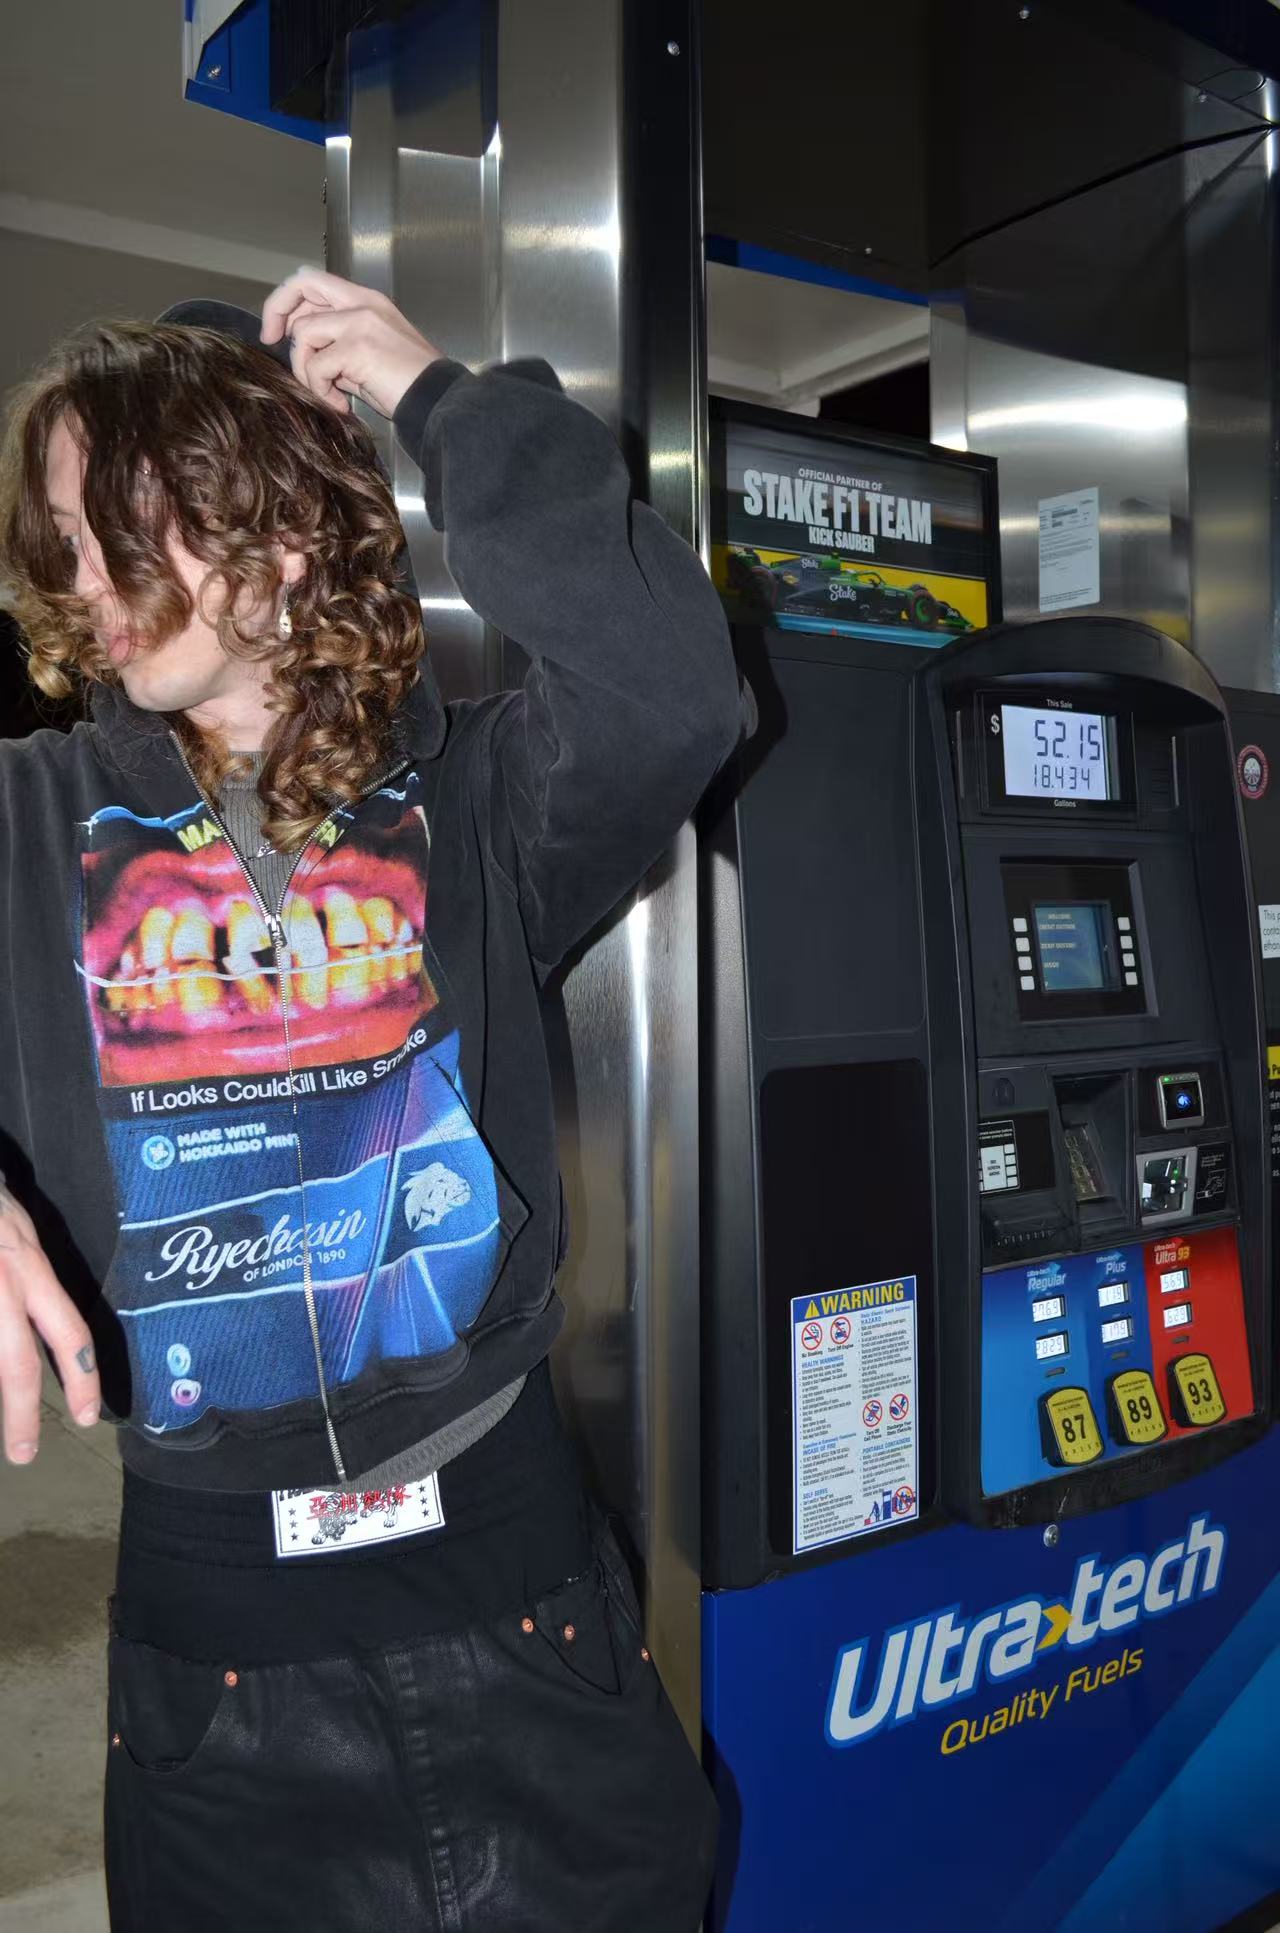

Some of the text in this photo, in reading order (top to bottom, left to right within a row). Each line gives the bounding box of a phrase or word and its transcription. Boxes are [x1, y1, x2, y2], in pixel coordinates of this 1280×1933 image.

[798, 467, 883, 492] OFFICIAL PARTNER OF
[743, 469, 932, 545] STAKE F1 TEAM
[808, 525, 875, 554] KICK SAUBER
[829, 583, 857, 601] Stake
[1046, 699, 1073, 709] This Sale
[990, 714, 1000, 735] $
[1034, 764, 1091, 790] 18.434
[1054, 799, 1077, 808] Gallons
[130, 1091, 145, 1113] If
[149, 1084, 218, 1111] Looks
[223, 1077, 291, 1102] Could
[321, 1069, 368, 1091] Like
[372, 1027, 427, 1080] Smoke
[177, 1121, 267, 1147] MADE WITH
[179, 1139, 262, 1163] HOKKAIDO
[242, 1267, 260, 1283] OF
[316, 1248, 346, 1264] 1890
[1105, 1260, 1127, 1275] Plus
[1155, 1245, 1191, 1265] Ultra 93
[1027, 1272, 1067, 1292] Regular
[821, 1282, 904, 1316] WARNING
[1187, 1378, 1213, 1406] 93
[1127, 1396, 1153, 1424] 89
[1061, 1413, 1087, 1443] 87
[940, 1647, 1144, 1755] Quality Fuels
